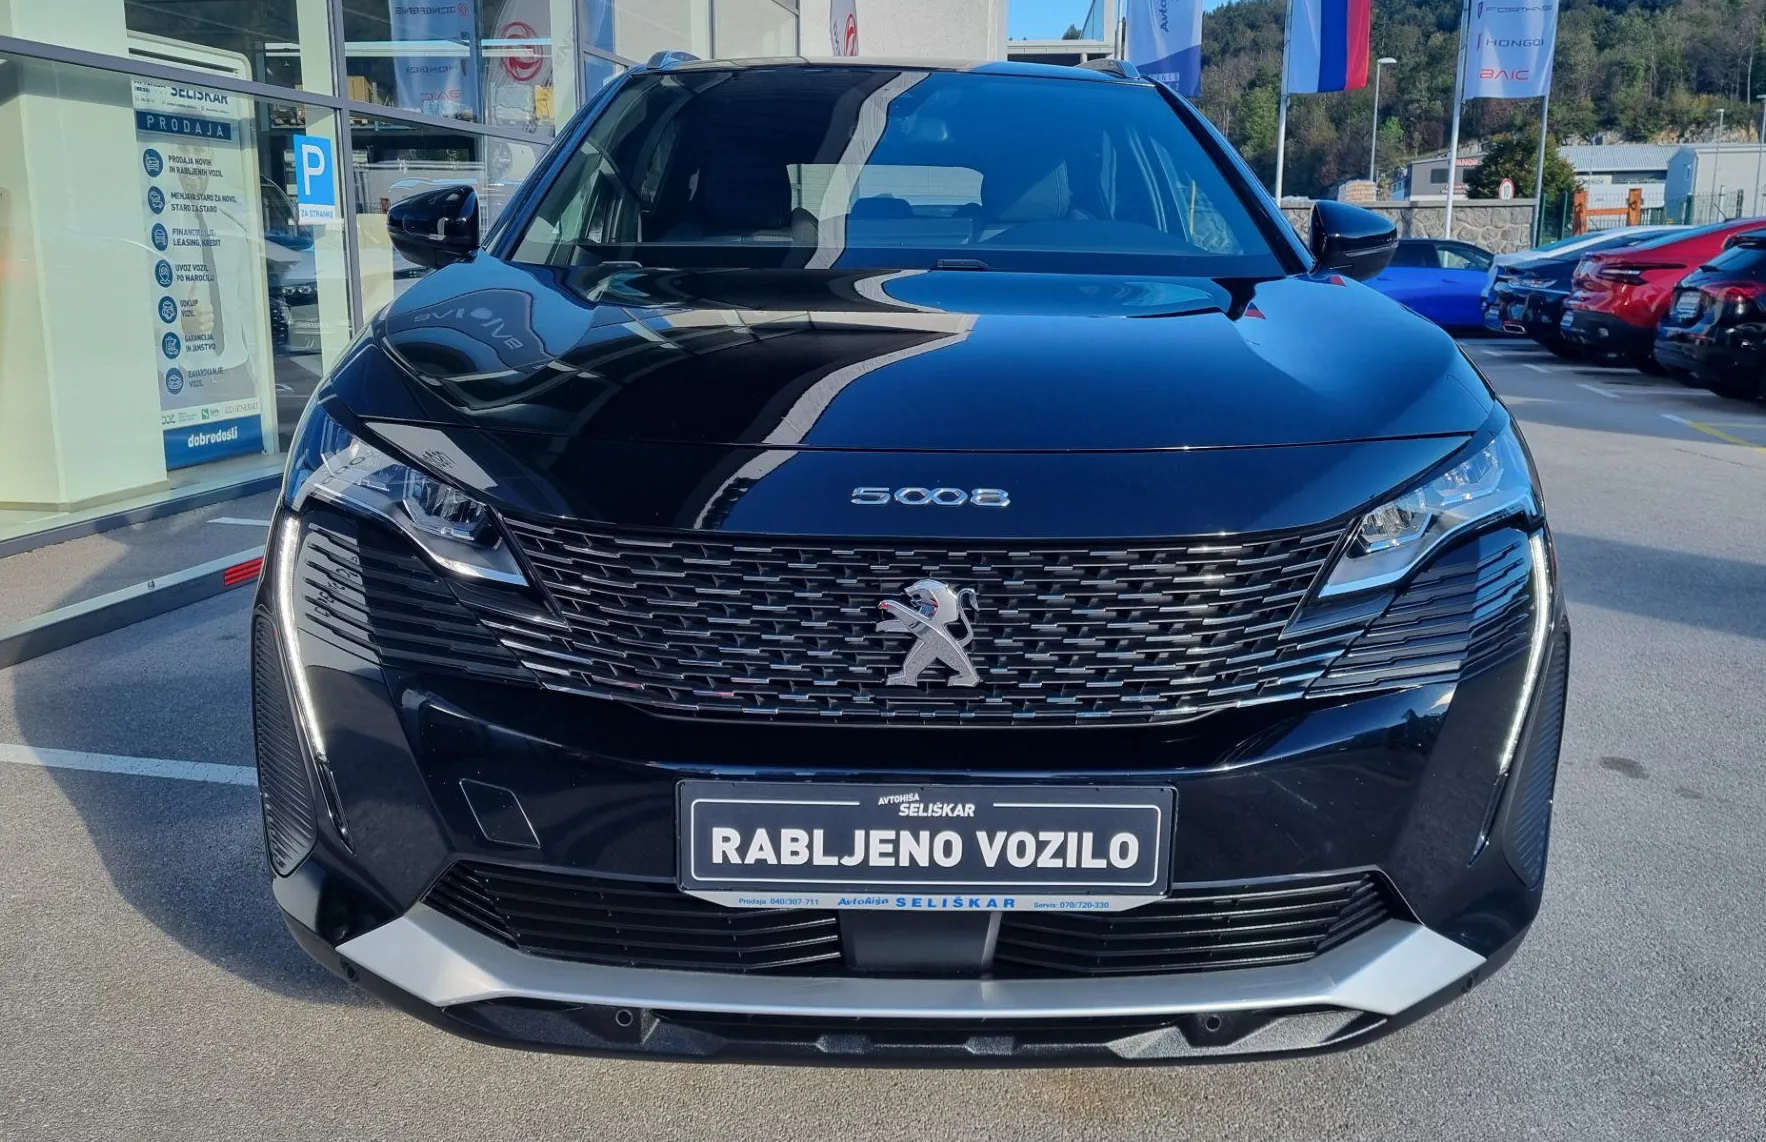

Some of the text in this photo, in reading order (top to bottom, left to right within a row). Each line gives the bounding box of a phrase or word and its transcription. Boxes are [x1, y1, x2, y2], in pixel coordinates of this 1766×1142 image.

[1480, 69, 1529, 80] BAIC
[146, 115, 224, 137] PRODAJA
[168, 155, 194, 165] PRODAJA
[302, 144, 325, 195] P
[851, 487, 1010, 507] 5008
[877, 792, 920, 806] AVTOHIŠA
[898, 802, 975, 818] SELIŠKAR
[711, 826, 1139, 869] RABLJENO VOZILO
[739, 897, 819, 906] Prodaja: 040/307-711
[895, 896, 1016, 909] SELIŠKAR
[1060, 901, 1110, 909] 070/720-330
